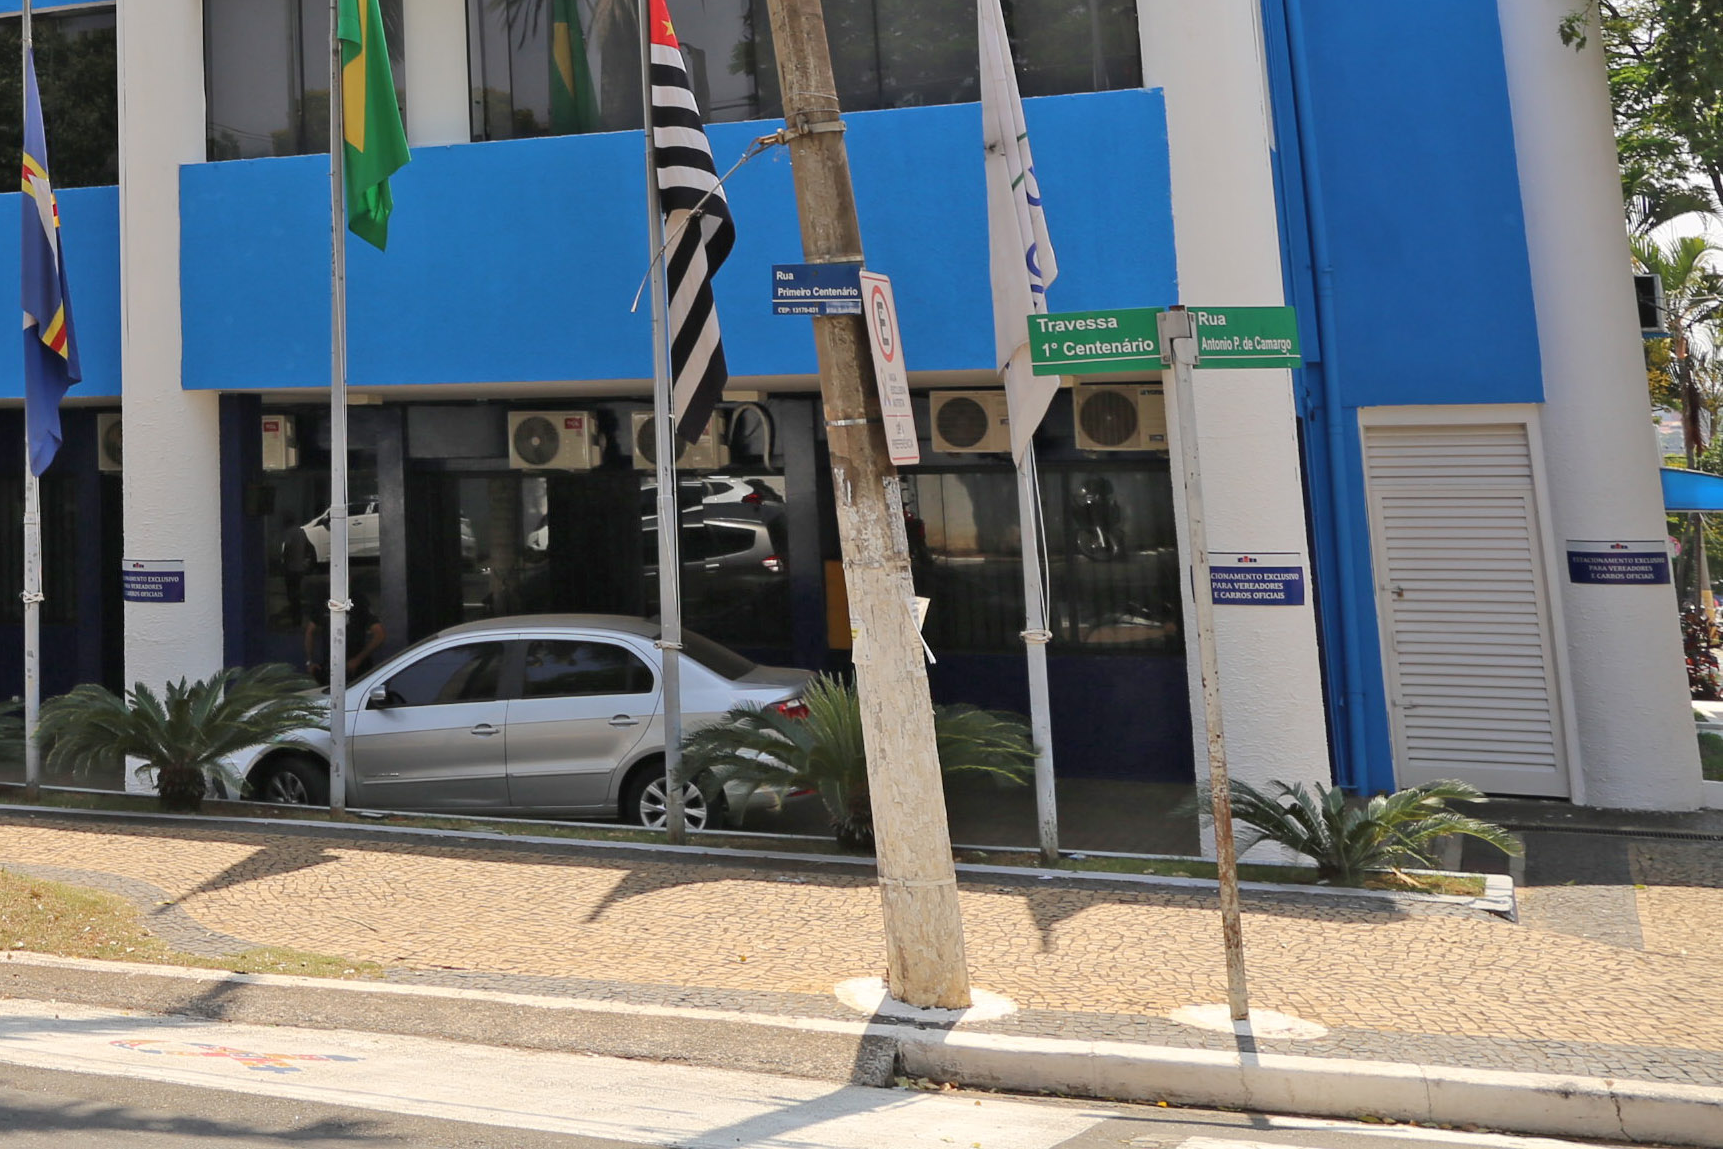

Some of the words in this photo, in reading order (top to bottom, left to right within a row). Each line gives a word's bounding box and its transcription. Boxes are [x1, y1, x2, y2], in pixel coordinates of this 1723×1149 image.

[776, 271, 794, 280] Rua
[777, 287, 811, 297] Primeiro
[812, 286, 858, 297] Centenário
[1198, 312, 1227, 326] Rua
[1036, 316, 1118, 334] Travessa
[1063, 338, 1154, 356] Centenário
[1201, 337, 1233, 351] Antonio
[1234, 337, 1242, 350] P.
[1243, 337, 1253, 350] de
[1254, 336, 1292, 355] Camargo
[1210, 572, 1263, 581] CIONAMENTO
[1264, 573, 1299, 581] EXCLUSIVO
[1234, 582, 1284, 590] VEREADORES
[1220, 591, 1252, 599] CARROS
[1253, 592, 1285, 600] OFICIAIS
